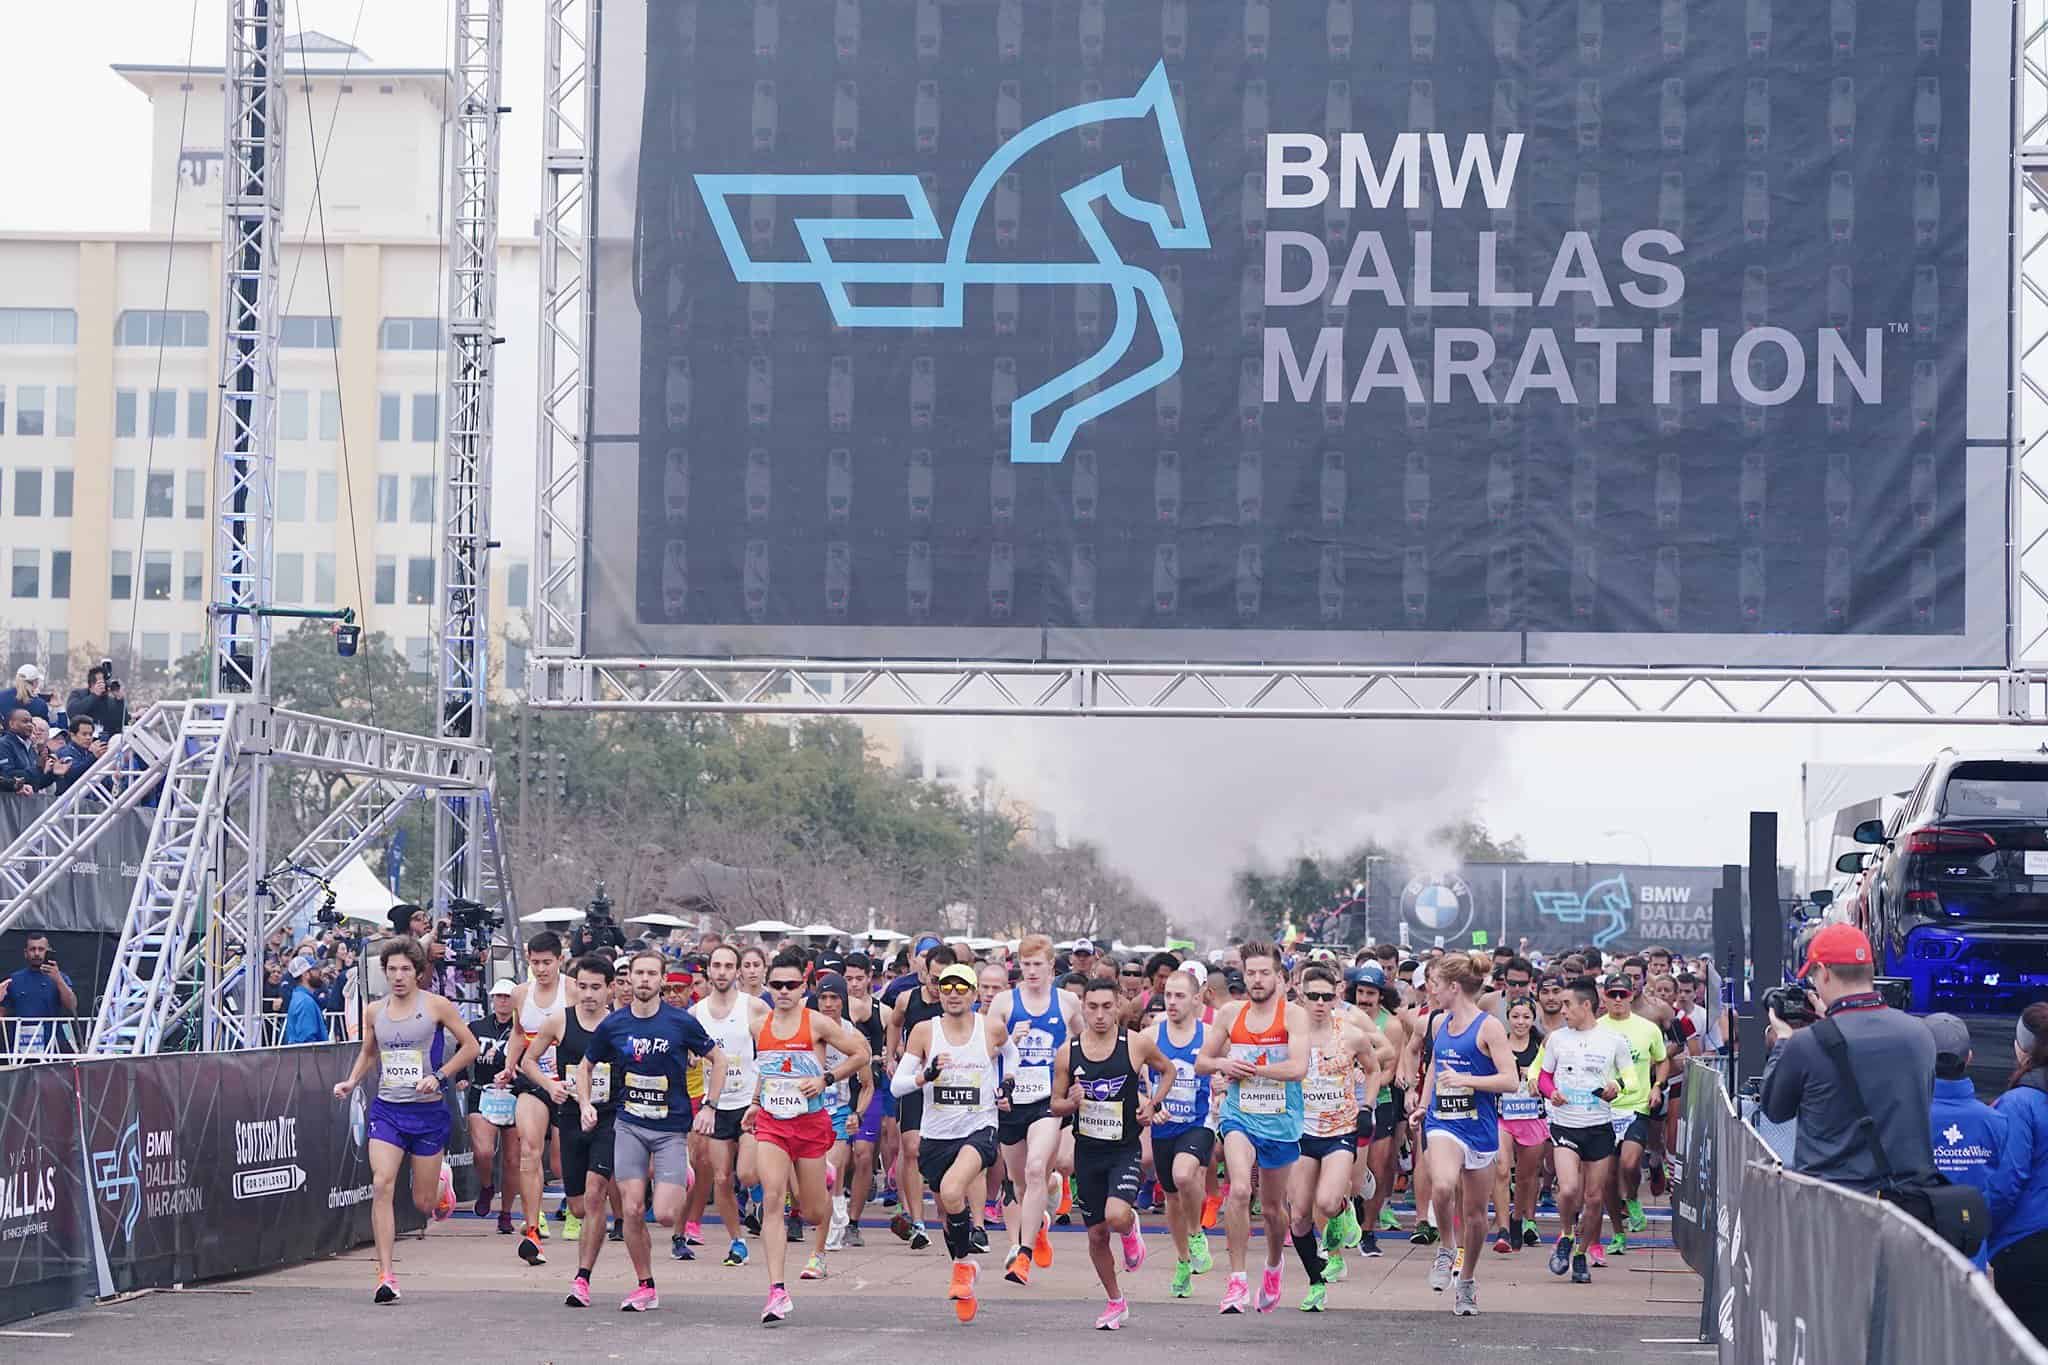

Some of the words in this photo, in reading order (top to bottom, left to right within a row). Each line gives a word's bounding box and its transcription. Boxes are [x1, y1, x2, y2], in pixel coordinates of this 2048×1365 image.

[1265, 132, 1525, 209] BMW
[1264, 229, 1685, 308] DALLAS
[1262, 326, 1882, 405] MARATHON
[1638, 886, 1691, 904] BMW
[386, 1067, 419, 1076] KOTAR
[571, 1077, 605, 1087] VES
[629, 1090, 665, 1102] GABLE
[770, 1096, 801, 1106] MENA
[941, 1090, 973, 1100] ELITE
[1240, 1092, 1286, 1101] CAMPBELL
[1303, 1091, 1345, 1101] POWELL
[1441, 1098, 1469, 1108] ELITE
[1079, 1115, 1122, 1128] HERRERA
[146, 1131, 173, 1158] BMW
[235, 1118, 278, 1165] SCOTTISH
[278, 1115, 297, 1159] RITE
[145, 1159, 187, 1188] DALLAS
[244, 1178, 258, 1190] FOR
[258, 1174, 288, 1188] CHILDREN
